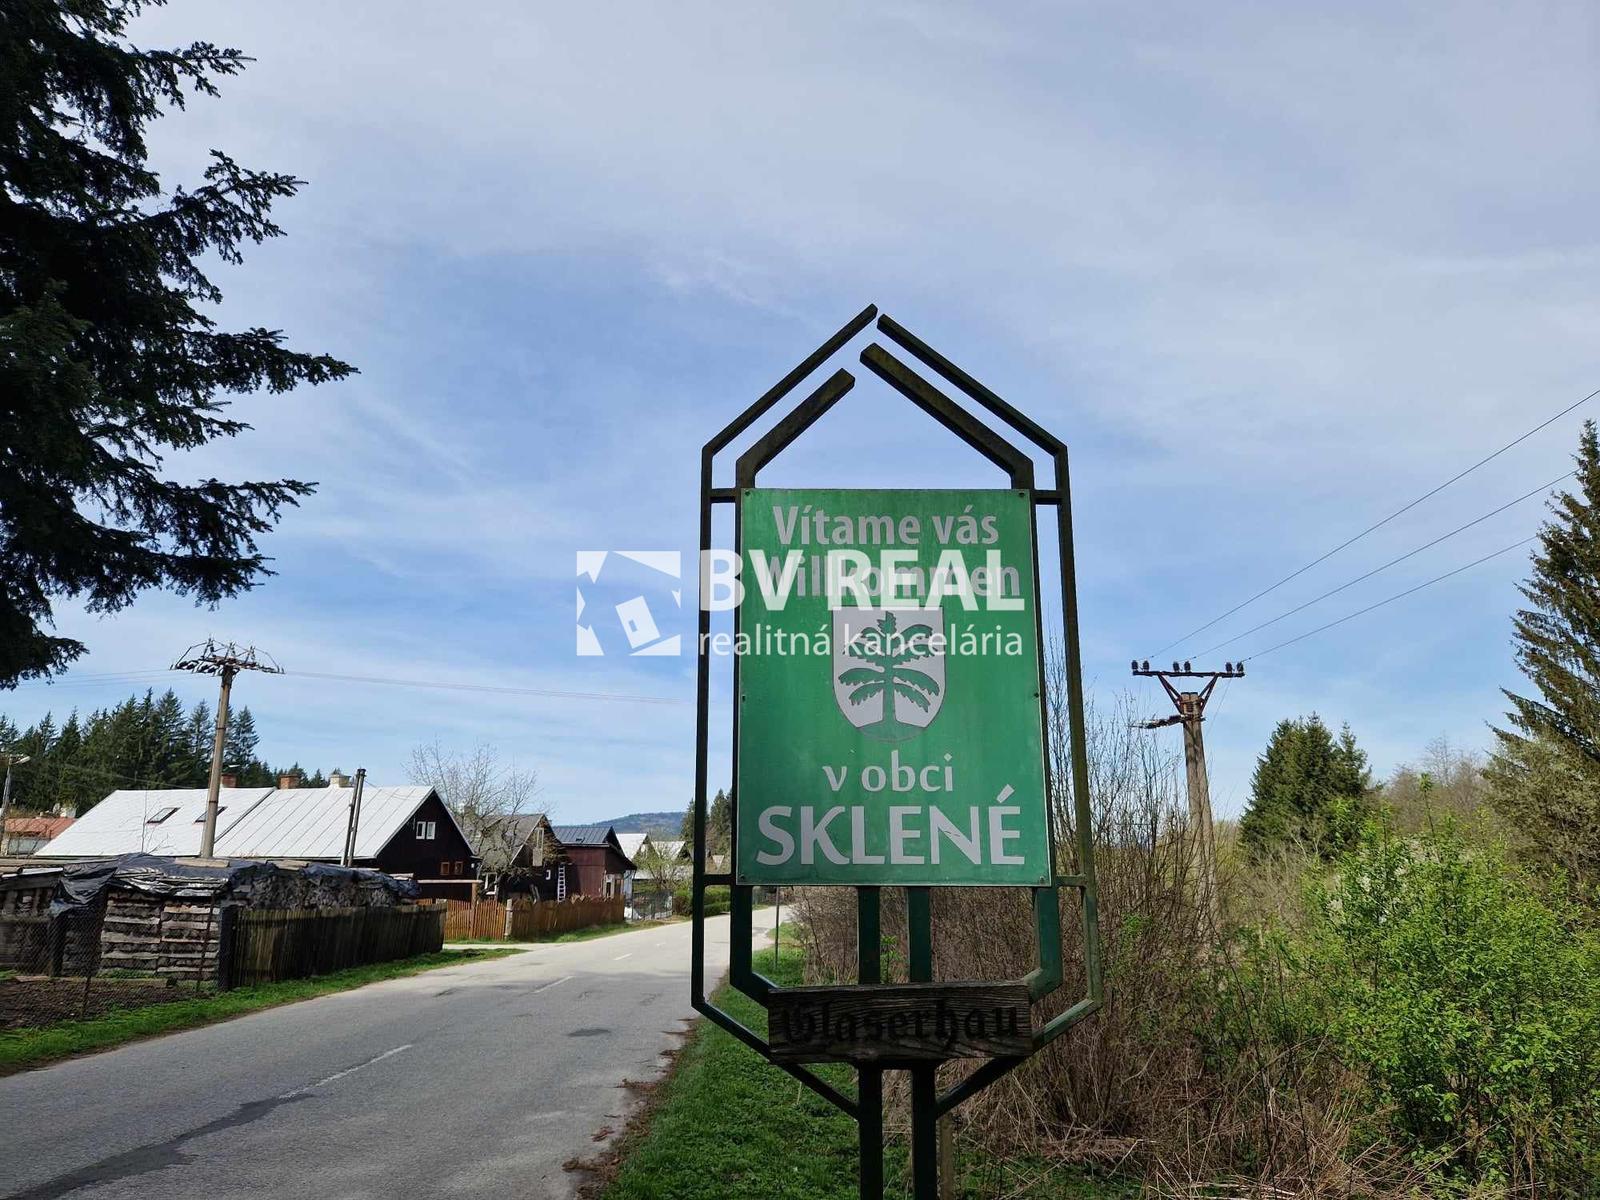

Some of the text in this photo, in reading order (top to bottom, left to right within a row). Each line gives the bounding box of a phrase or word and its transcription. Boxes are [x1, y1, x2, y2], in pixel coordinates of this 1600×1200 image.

[772, 505, 999, 546] Vítame vás
[822, 749, 953, 792] v obci
[756, 783, 1026, 866] SKLENÉ
